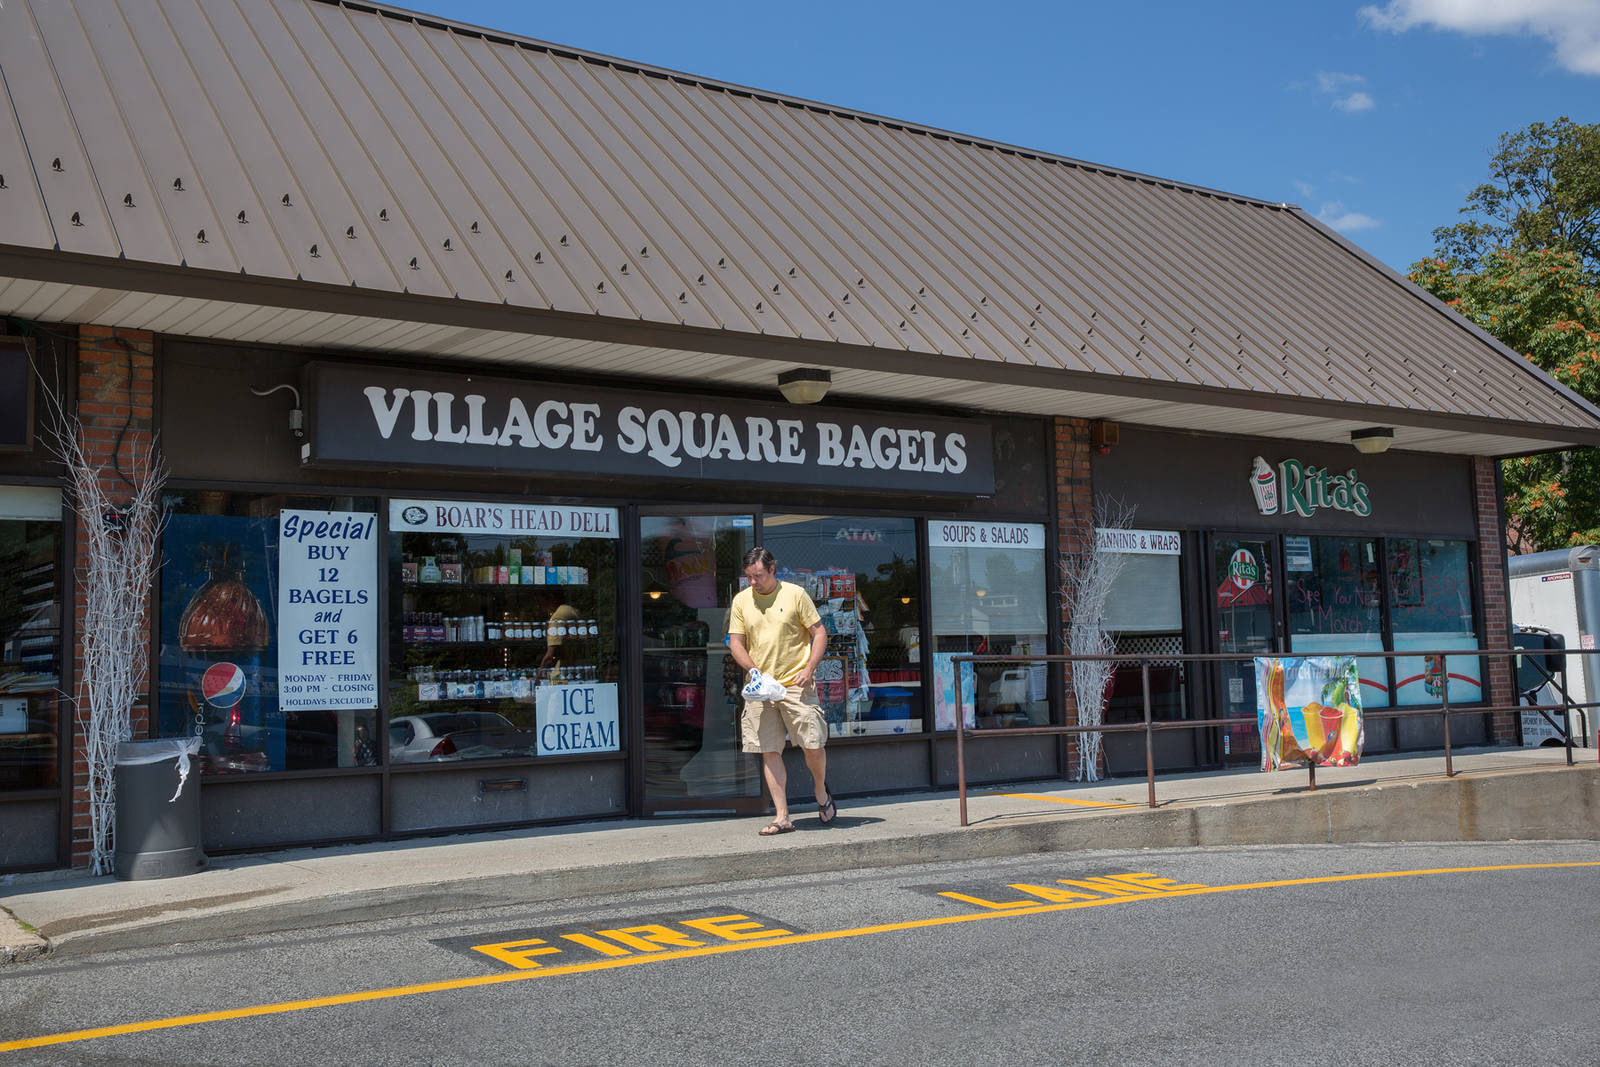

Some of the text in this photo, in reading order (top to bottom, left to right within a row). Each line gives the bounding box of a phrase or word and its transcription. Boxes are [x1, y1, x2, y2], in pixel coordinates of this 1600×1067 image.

[363, 385, 967, 475] VILLAGE SQUARE BAGELS
[1278, 458, 1371, 518] Rita's
[283, 514, 374, 543] Special
[436, 506, 610, 533] BOAR'S HEAD DELI
[943, 525, 1029, 544] SOUPS & SALADS
[1140, 535, 1147, 550] &
[1149, 534, 1179, 551] WRAPS
[307, 545, 349, 560] BUY
[318, 567, 339, 582] 12
[1232, 561, 1256, 577] Rita's
[289, 588, 368, 604] BAGELS
[1296, 578, 1321, 604] See
[1333, 586, 1352, 605] You
[314, 608, 343, 623] and
[1318, 605, 1363, 634] March
[298, 629, 358, 645] GET 6
[302, 650, 356, 666] FREE
[284, 674, 327, 683] MONDAY
[337, 673, 373, 682] FRIDAY
[283, 685, 303, 693] 3:00
[306, 684, 320, 693] PM
[331, 684, 374, 692] CLOSING
[286, 697, 373, 706] HOLIDAYS EXCLUDED
[561, 687, 595, 716] ICE
[541, 720, 616, 752] CREAM
[939, 872, 1209, 910] LANE
[471, 914, 793, 970] FIRE
